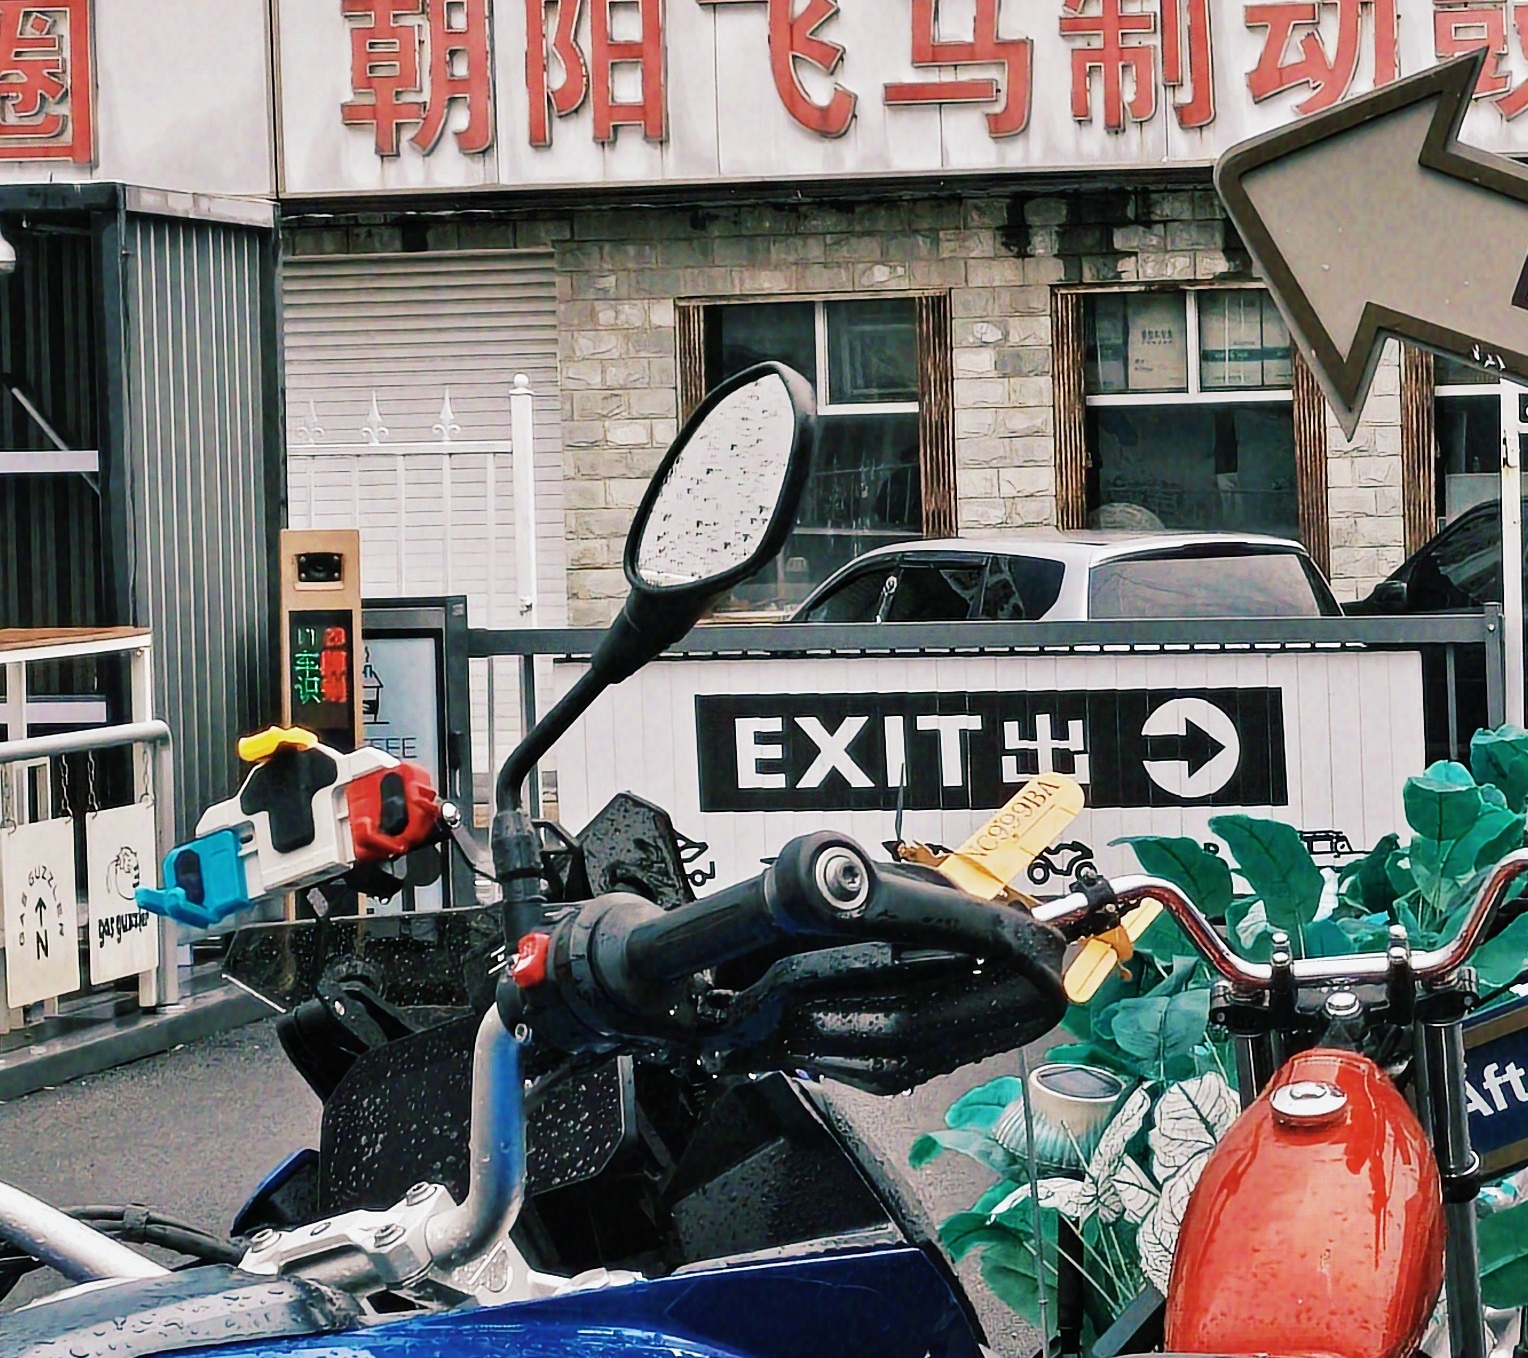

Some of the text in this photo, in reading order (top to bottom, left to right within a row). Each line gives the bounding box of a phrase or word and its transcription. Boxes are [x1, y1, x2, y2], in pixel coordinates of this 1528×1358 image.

[734, 711, 1089, 790] EXIT 出
[36, 929, 48, 960] N
